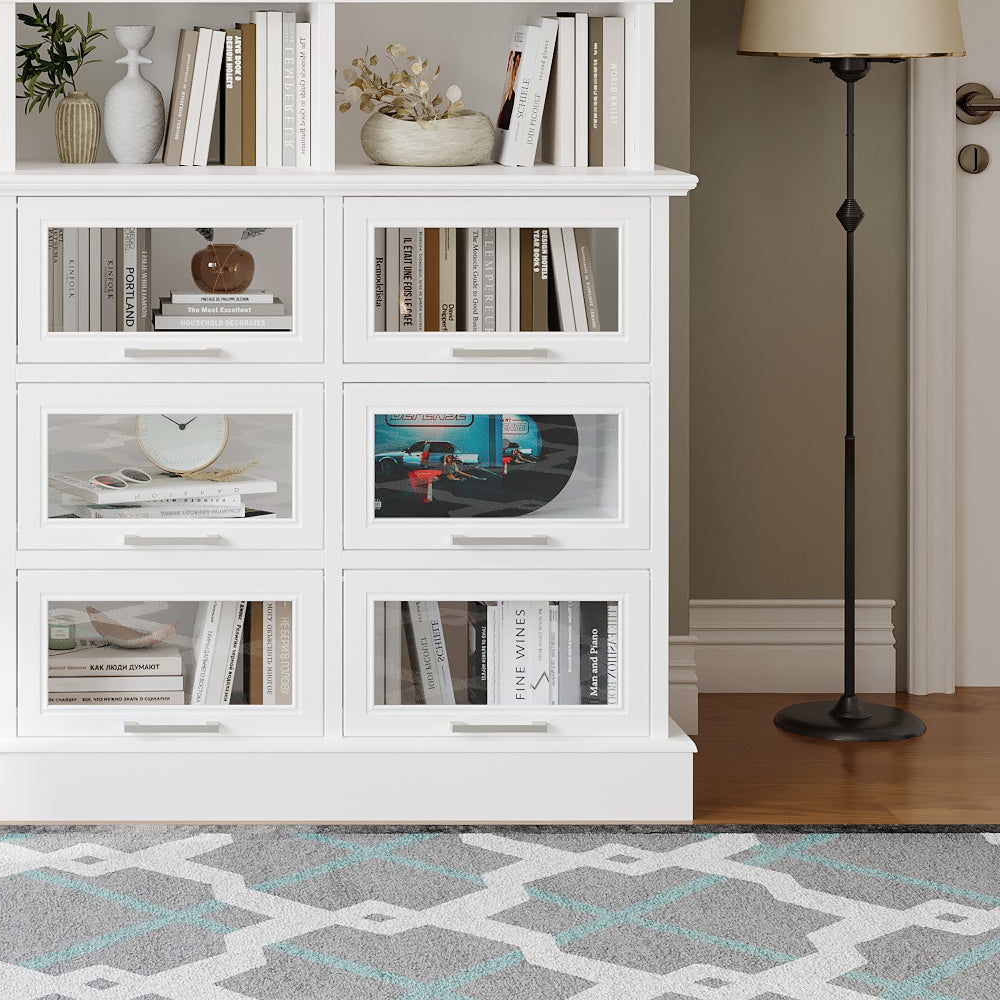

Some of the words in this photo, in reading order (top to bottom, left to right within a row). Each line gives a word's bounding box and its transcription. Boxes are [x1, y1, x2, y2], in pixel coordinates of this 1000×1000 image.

[516, 78, 531, 119] SCHIELE
[529, 93, 541, 127] PICOULT
[68, 259, 76, 299] KINFOLK
[107, 260, 115, 300] KINFOLK
[375, 257, 384, 307] Remodelista
[403, 266, 413, 281] UNE
[125, 267, 135, 327] PORTLAND
[403, 282, 413, 297] FOIS
[180, 319, 223, 327] HOUSEHOLD
[225, 319, 266, 327] DECORATES
[280, 617, 290, 628] НЕ
[515, 609, 525, 660] WINES
[280, 629, 290, 652] БЕРИ
[589, 628, 598, 654] Piano
[280, 661, 290, 695] ГОЛОВУ
[589, 656, 598, 674] and
[195, 677, 204, 703] ВОСТОКА
[515, 667, 525, 700] FINE
[589, 675, 598, 697] Man
